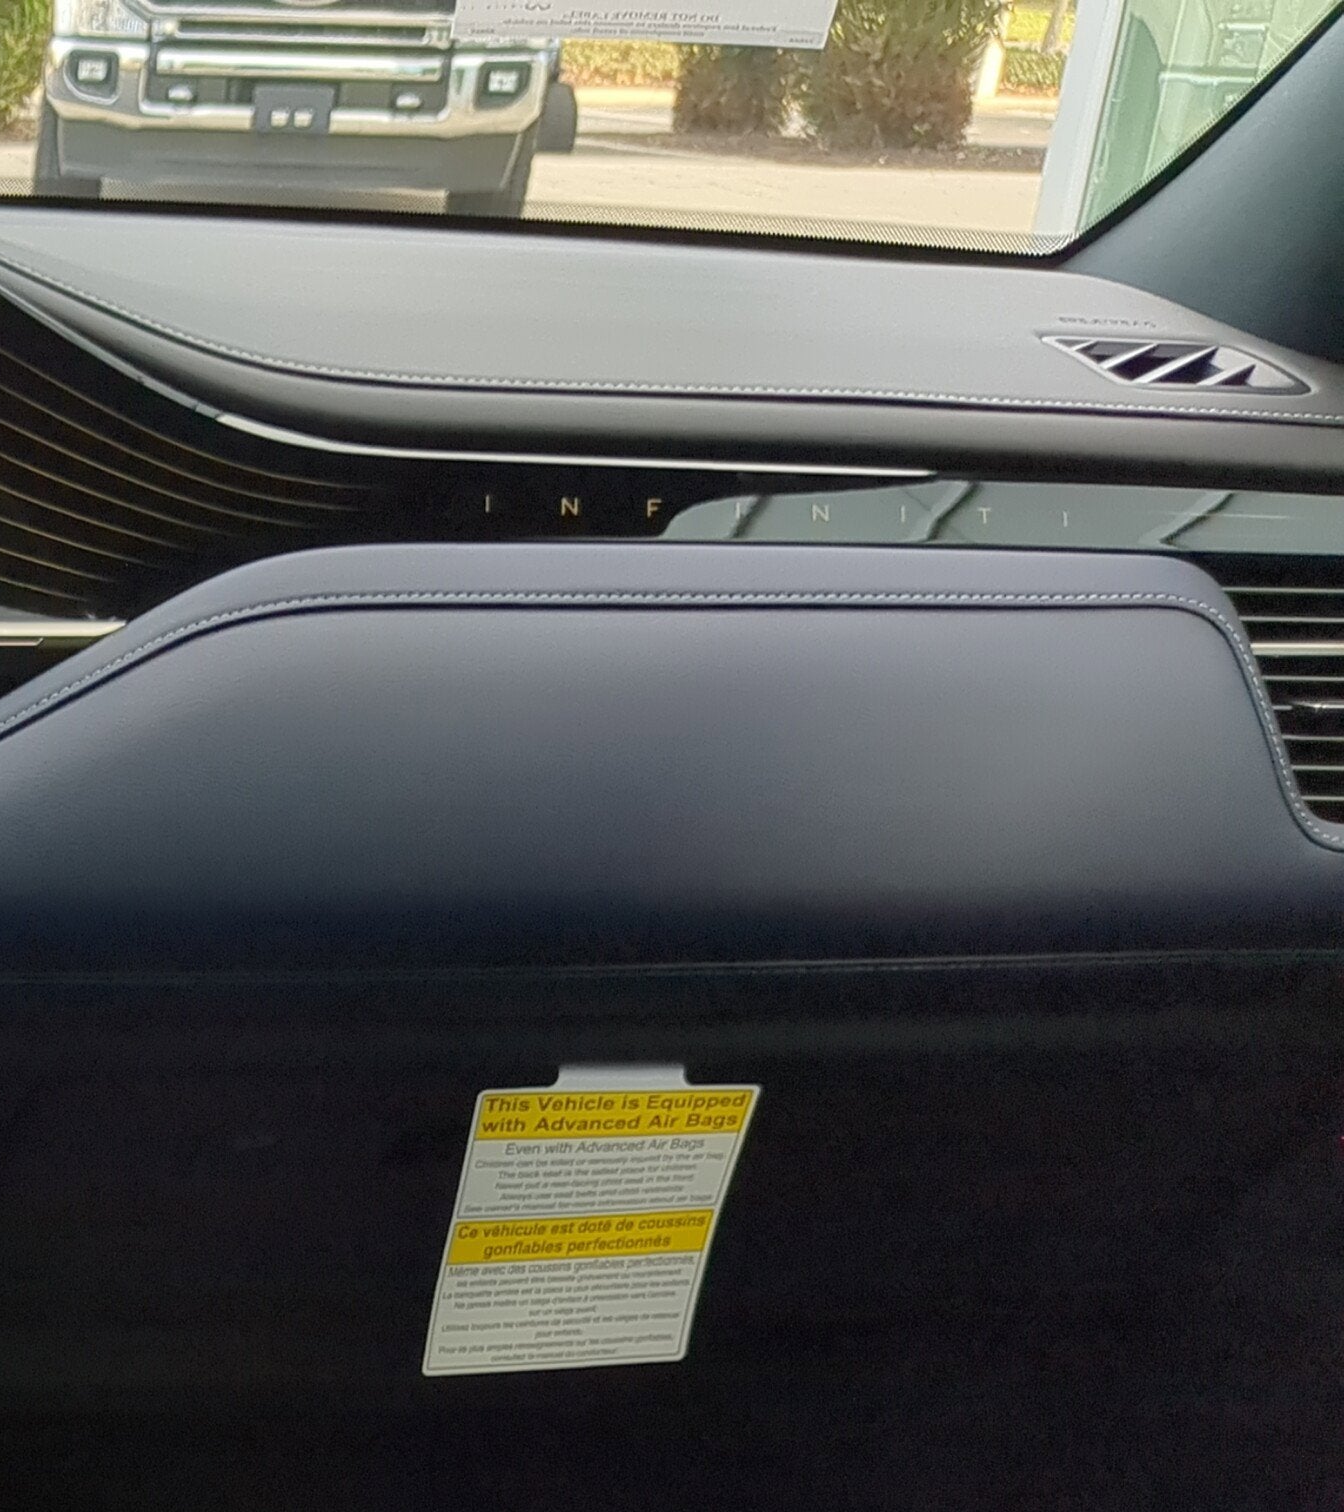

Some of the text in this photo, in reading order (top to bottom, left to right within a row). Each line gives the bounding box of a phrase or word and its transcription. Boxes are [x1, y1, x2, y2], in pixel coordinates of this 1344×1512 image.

[487, 1092, 746, 1113] This Vehicle is Equipped
[482, 1112, 738, 1132] with Advanced Air Bags
[505, 1137, 705, 1156] Even with Advanced Air Bags
[457, 1215, 706, 1239] Ce véhicule est doté de coussins
[483, 1235, 672, 1259] gonflables perfectionnés
